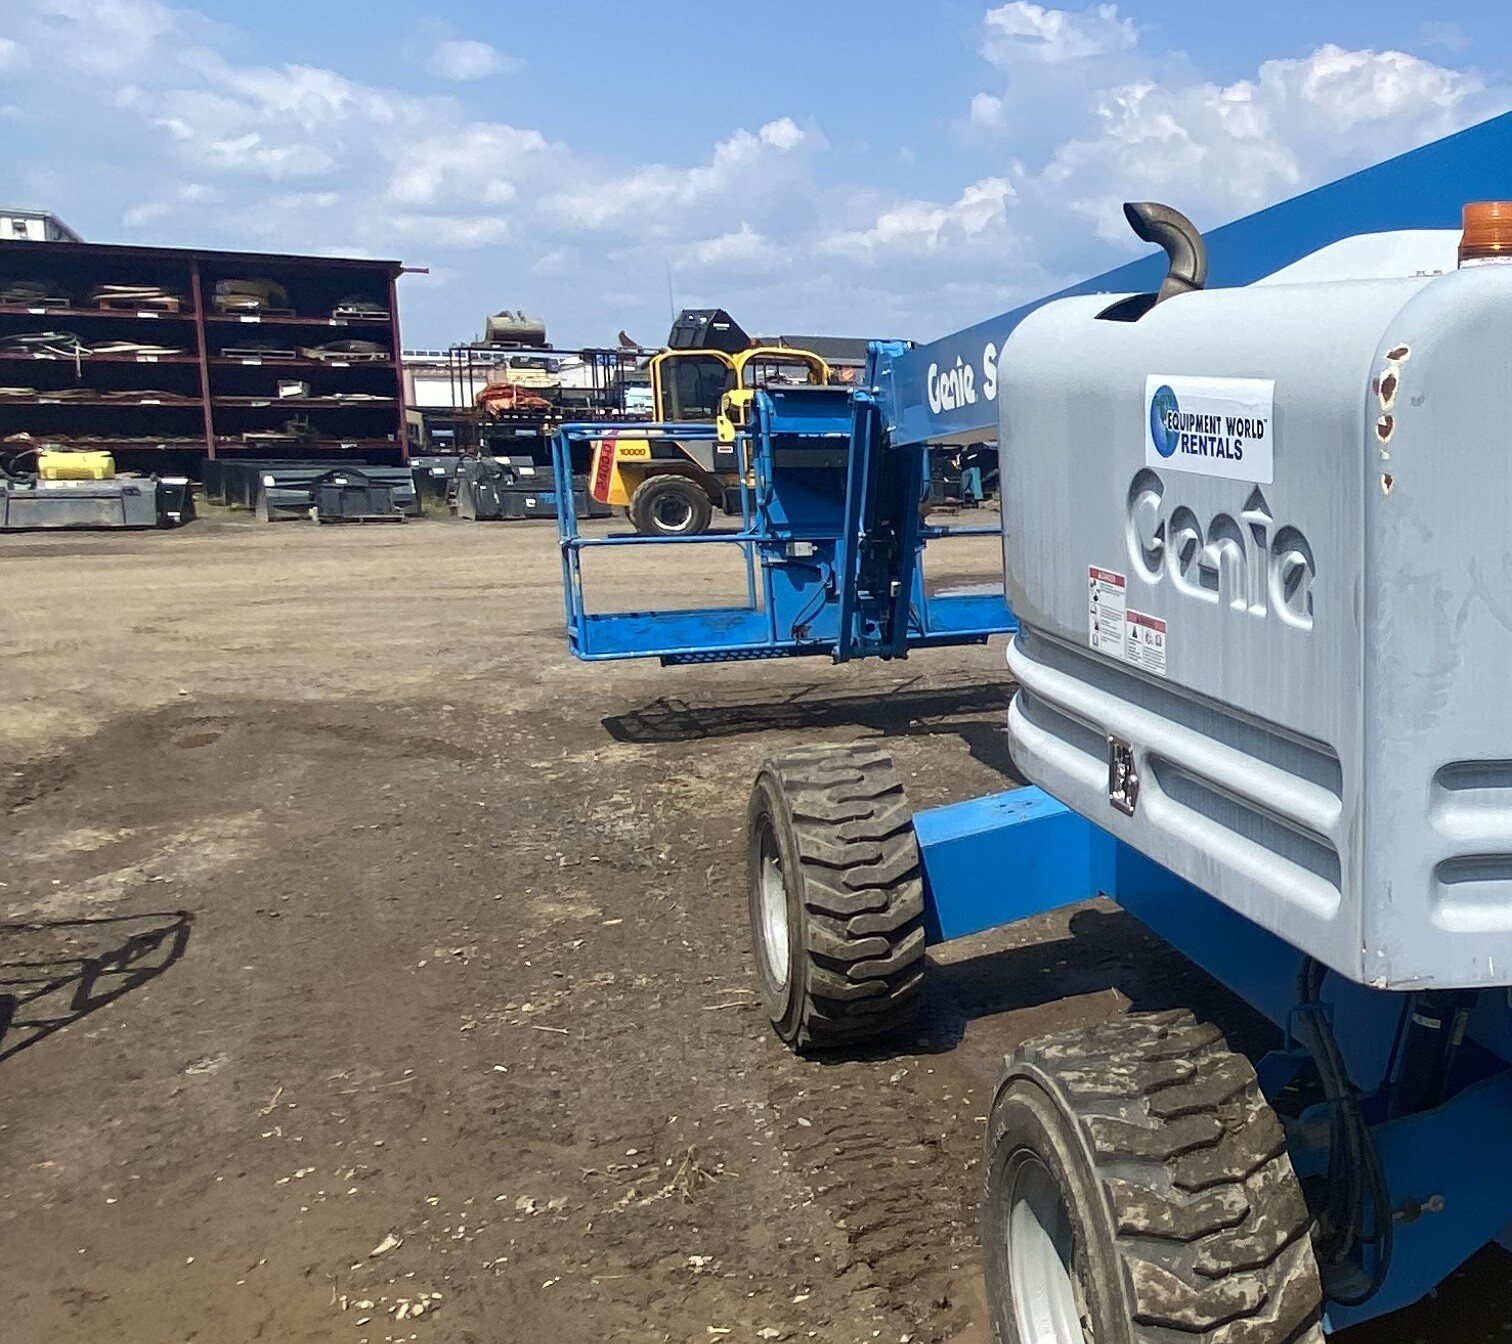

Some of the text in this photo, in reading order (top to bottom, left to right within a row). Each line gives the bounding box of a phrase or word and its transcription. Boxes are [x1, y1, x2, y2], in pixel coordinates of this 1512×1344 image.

[927, 354, 976, 414] Genie
[1167, 411, 1221, 435] EQUIPMENT
[1181, 433, 1243, 461] RENTALS
[1126, 467, 1316, 632] Genie
